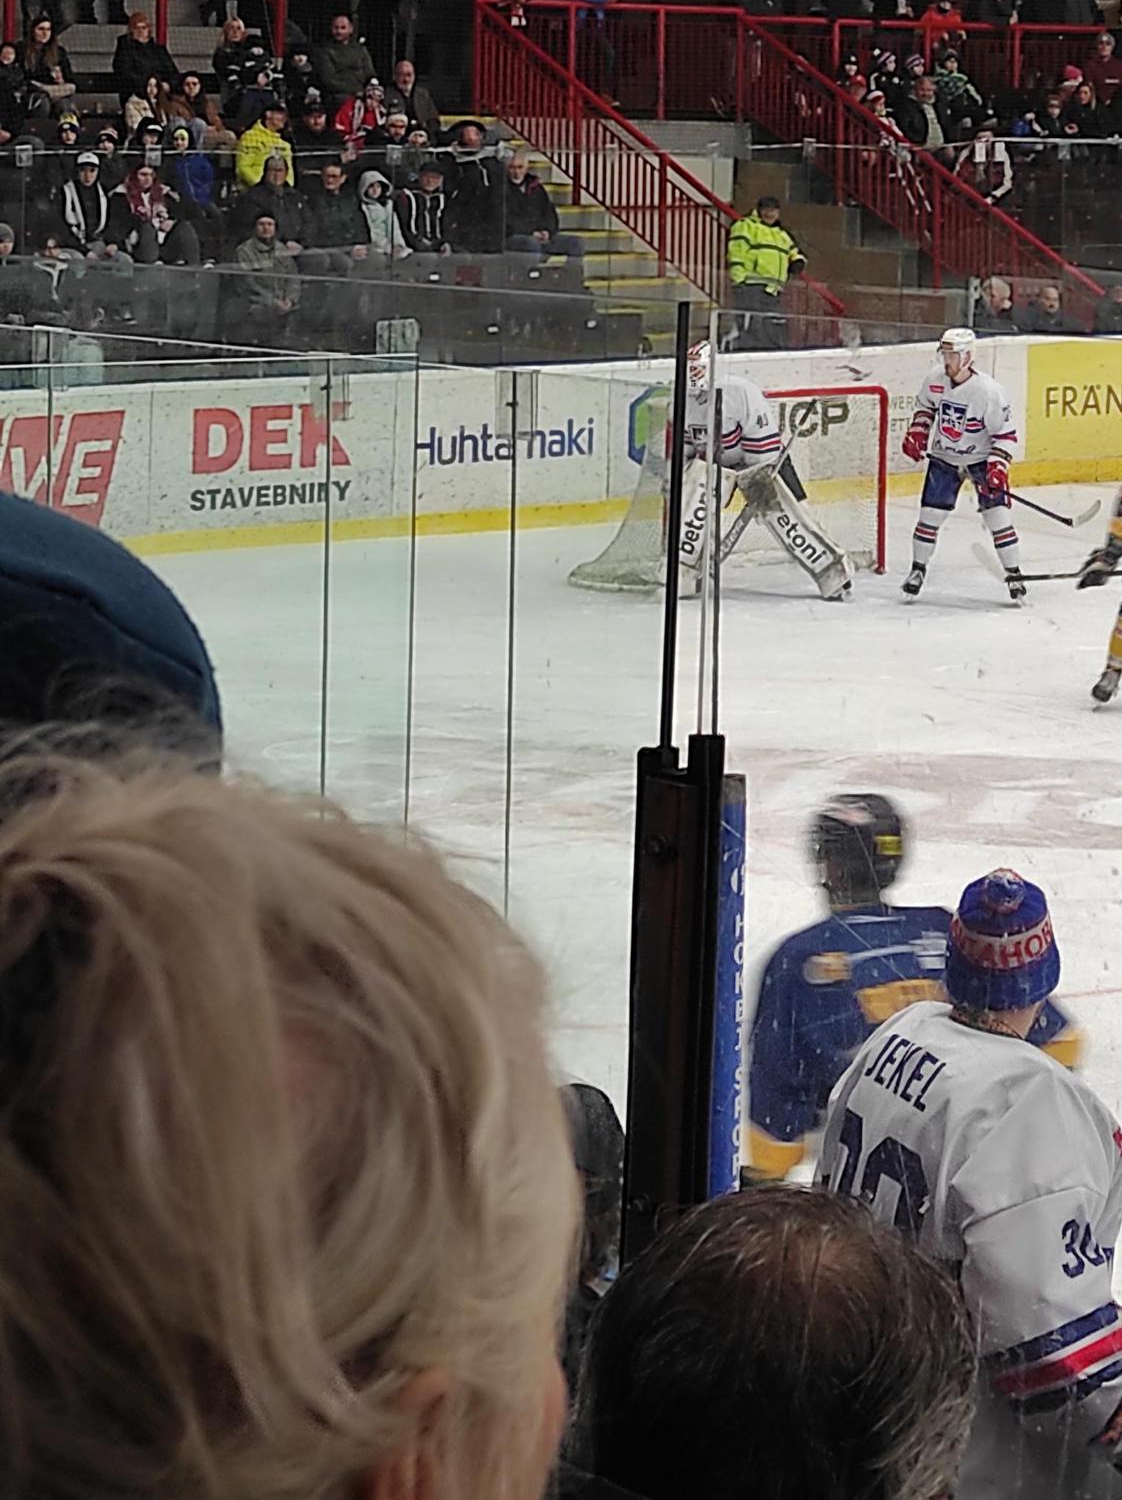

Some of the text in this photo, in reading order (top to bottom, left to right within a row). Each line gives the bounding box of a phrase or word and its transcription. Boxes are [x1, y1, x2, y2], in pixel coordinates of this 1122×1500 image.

[192, 403, 352, 475] DEK
[777, 513, 828, 565] etoni
[864, 1033, 947, 1113] JEKEL
